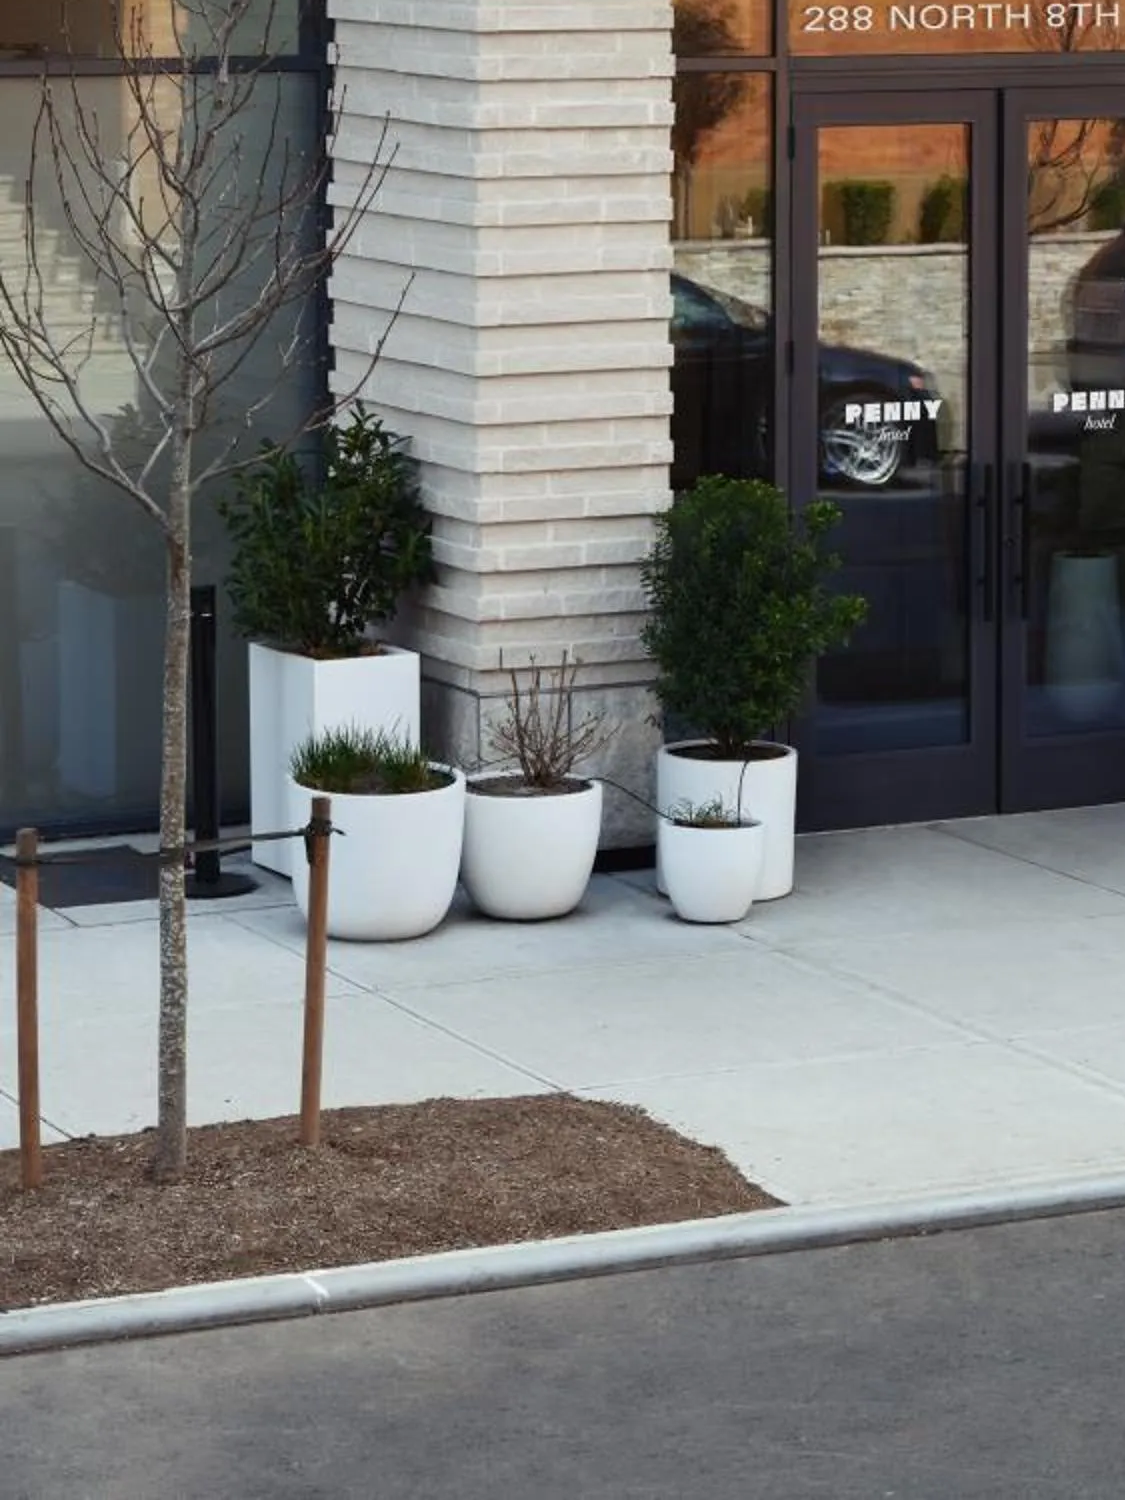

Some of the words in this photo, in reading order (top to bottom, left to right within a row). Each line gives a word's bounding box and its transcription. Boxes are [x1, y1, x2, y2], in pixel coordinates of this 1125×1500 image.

[803, 4, 874, 32] 288
[890, 2, 1031, 31] NORTH
[1046, 2, 1120, 28] 8TH
[844, 399, 943, 424] PENNY
